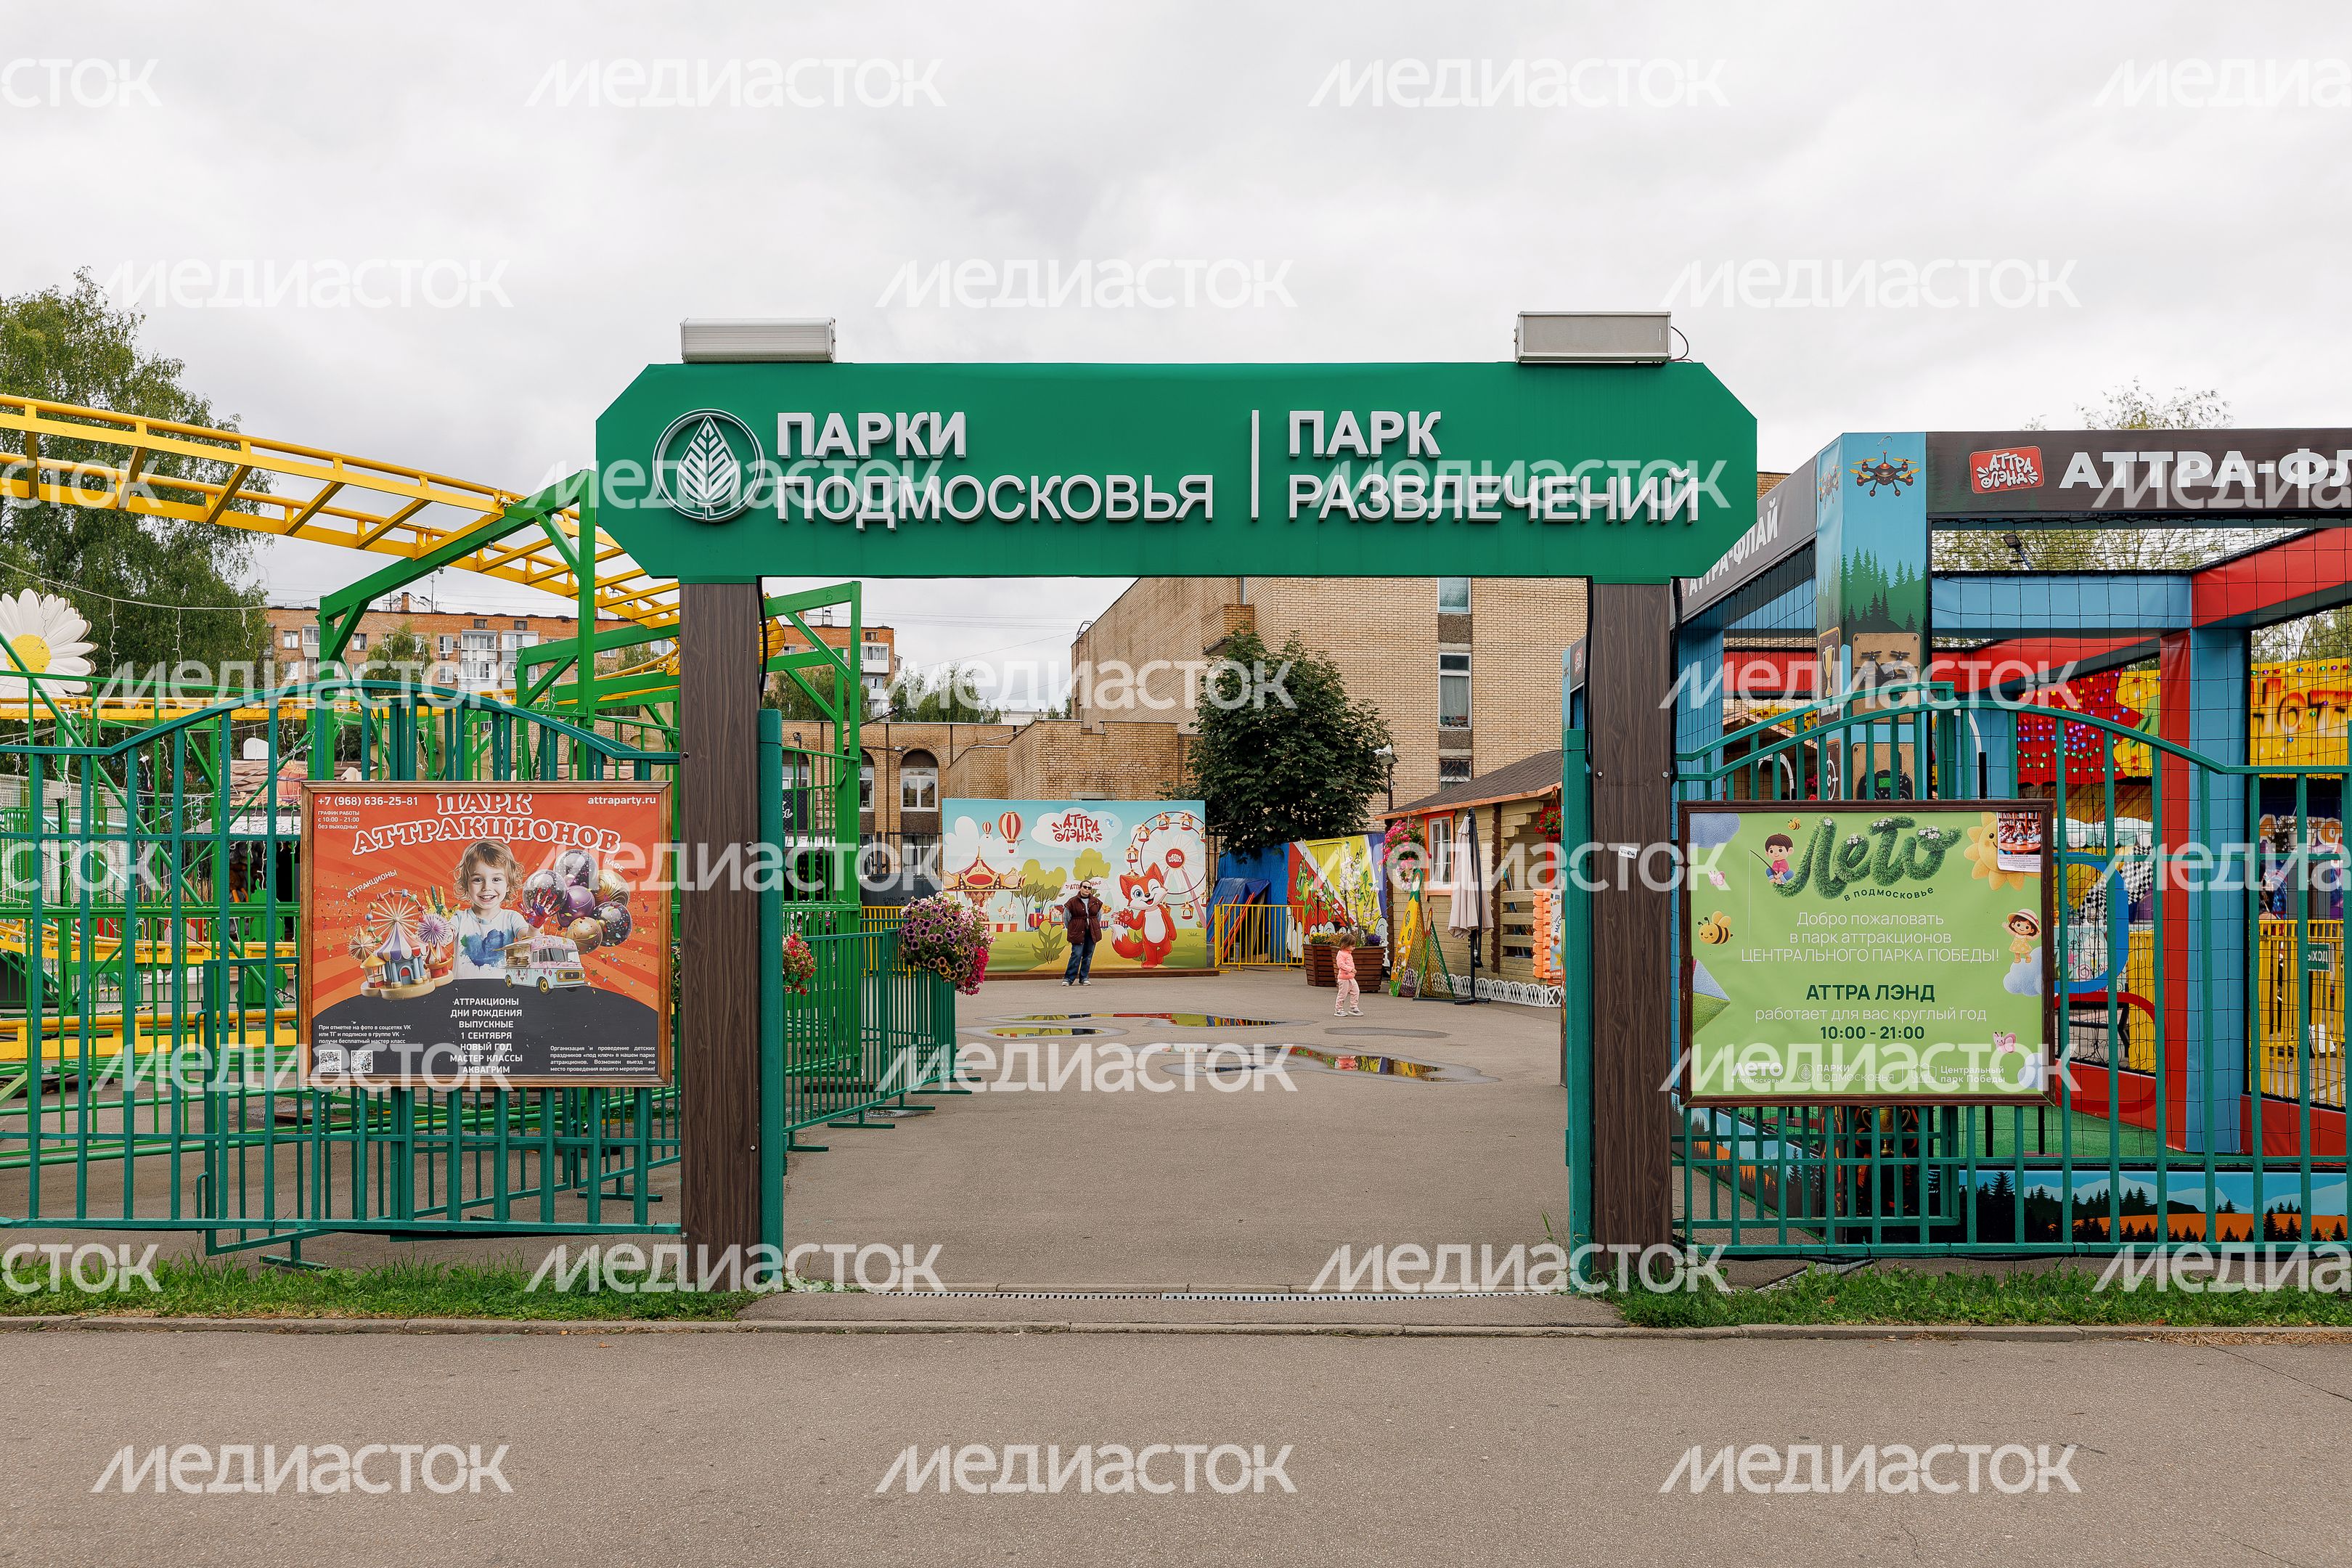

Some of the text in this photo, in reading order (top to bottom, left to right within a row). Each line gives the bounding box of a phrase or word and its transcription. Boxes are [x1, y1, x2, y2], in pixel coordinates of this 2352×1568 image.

[777, 412, 967, 460] ПАРКИ
[1289, 410, 1442, 458] ПАРК
[1989, 452, 2033, 473] АТТРА
[1981, 470, 2028, 489] ЛЭНД
[777, 474, 1214, 531] ПОДМОСКОВЬЯ
[1289, 468, 1701, 525] РАЗВЛЕЧЕНИЙ
[318, 796, 418, 807] +7 (968) 636-25-81
[436, 793, 533, 814] ПАРК
[587, 796, 656, 807] attraparty.ru
[1063, 814, 1100, 833] АТТРА
[351, 815, 621, 856] АТТРАКЦИОНОВ
[1054, 828, 1094, 843] ЛЭНД
[605, 857, 626, 873] КАФЕ
[347, 869, 397, 899] АТТРАКЦИОНЫ
[1853, 887, 1934, 899] подмосковье
[1797, 912, 1943, 928] Добро пожаловать
[1789, 932, 1951, 946] в парк аттракционов
[1741, 948, 1999, 963] ЦЕНТРАЛЬНОГО ПАРКА ПОБЕДЫ!
[1806, 984, 1935, 1003] АТТРА ЛЭНД
[454, 998, 519, 1007] АТТРАКЦИОНЫ
[450, 1009, 522, 1018] ДНИ РОЖДЕНИЯ
[1755, 1007, 1987, 1023] работает для вас круглый год
[1821, 1026, 1866, 1040] 10:00
[1879, 1026, 1924, 1040] 21:00
[460, 1042, 491, 1050] НОВЫЙ
[1816, 1074, 1894, 1082] ПОДМОСКОВЬЯ
[1940, 1066, 2004, 1075] Центральный
[1967, 1074, 2005, 1083] Победы
